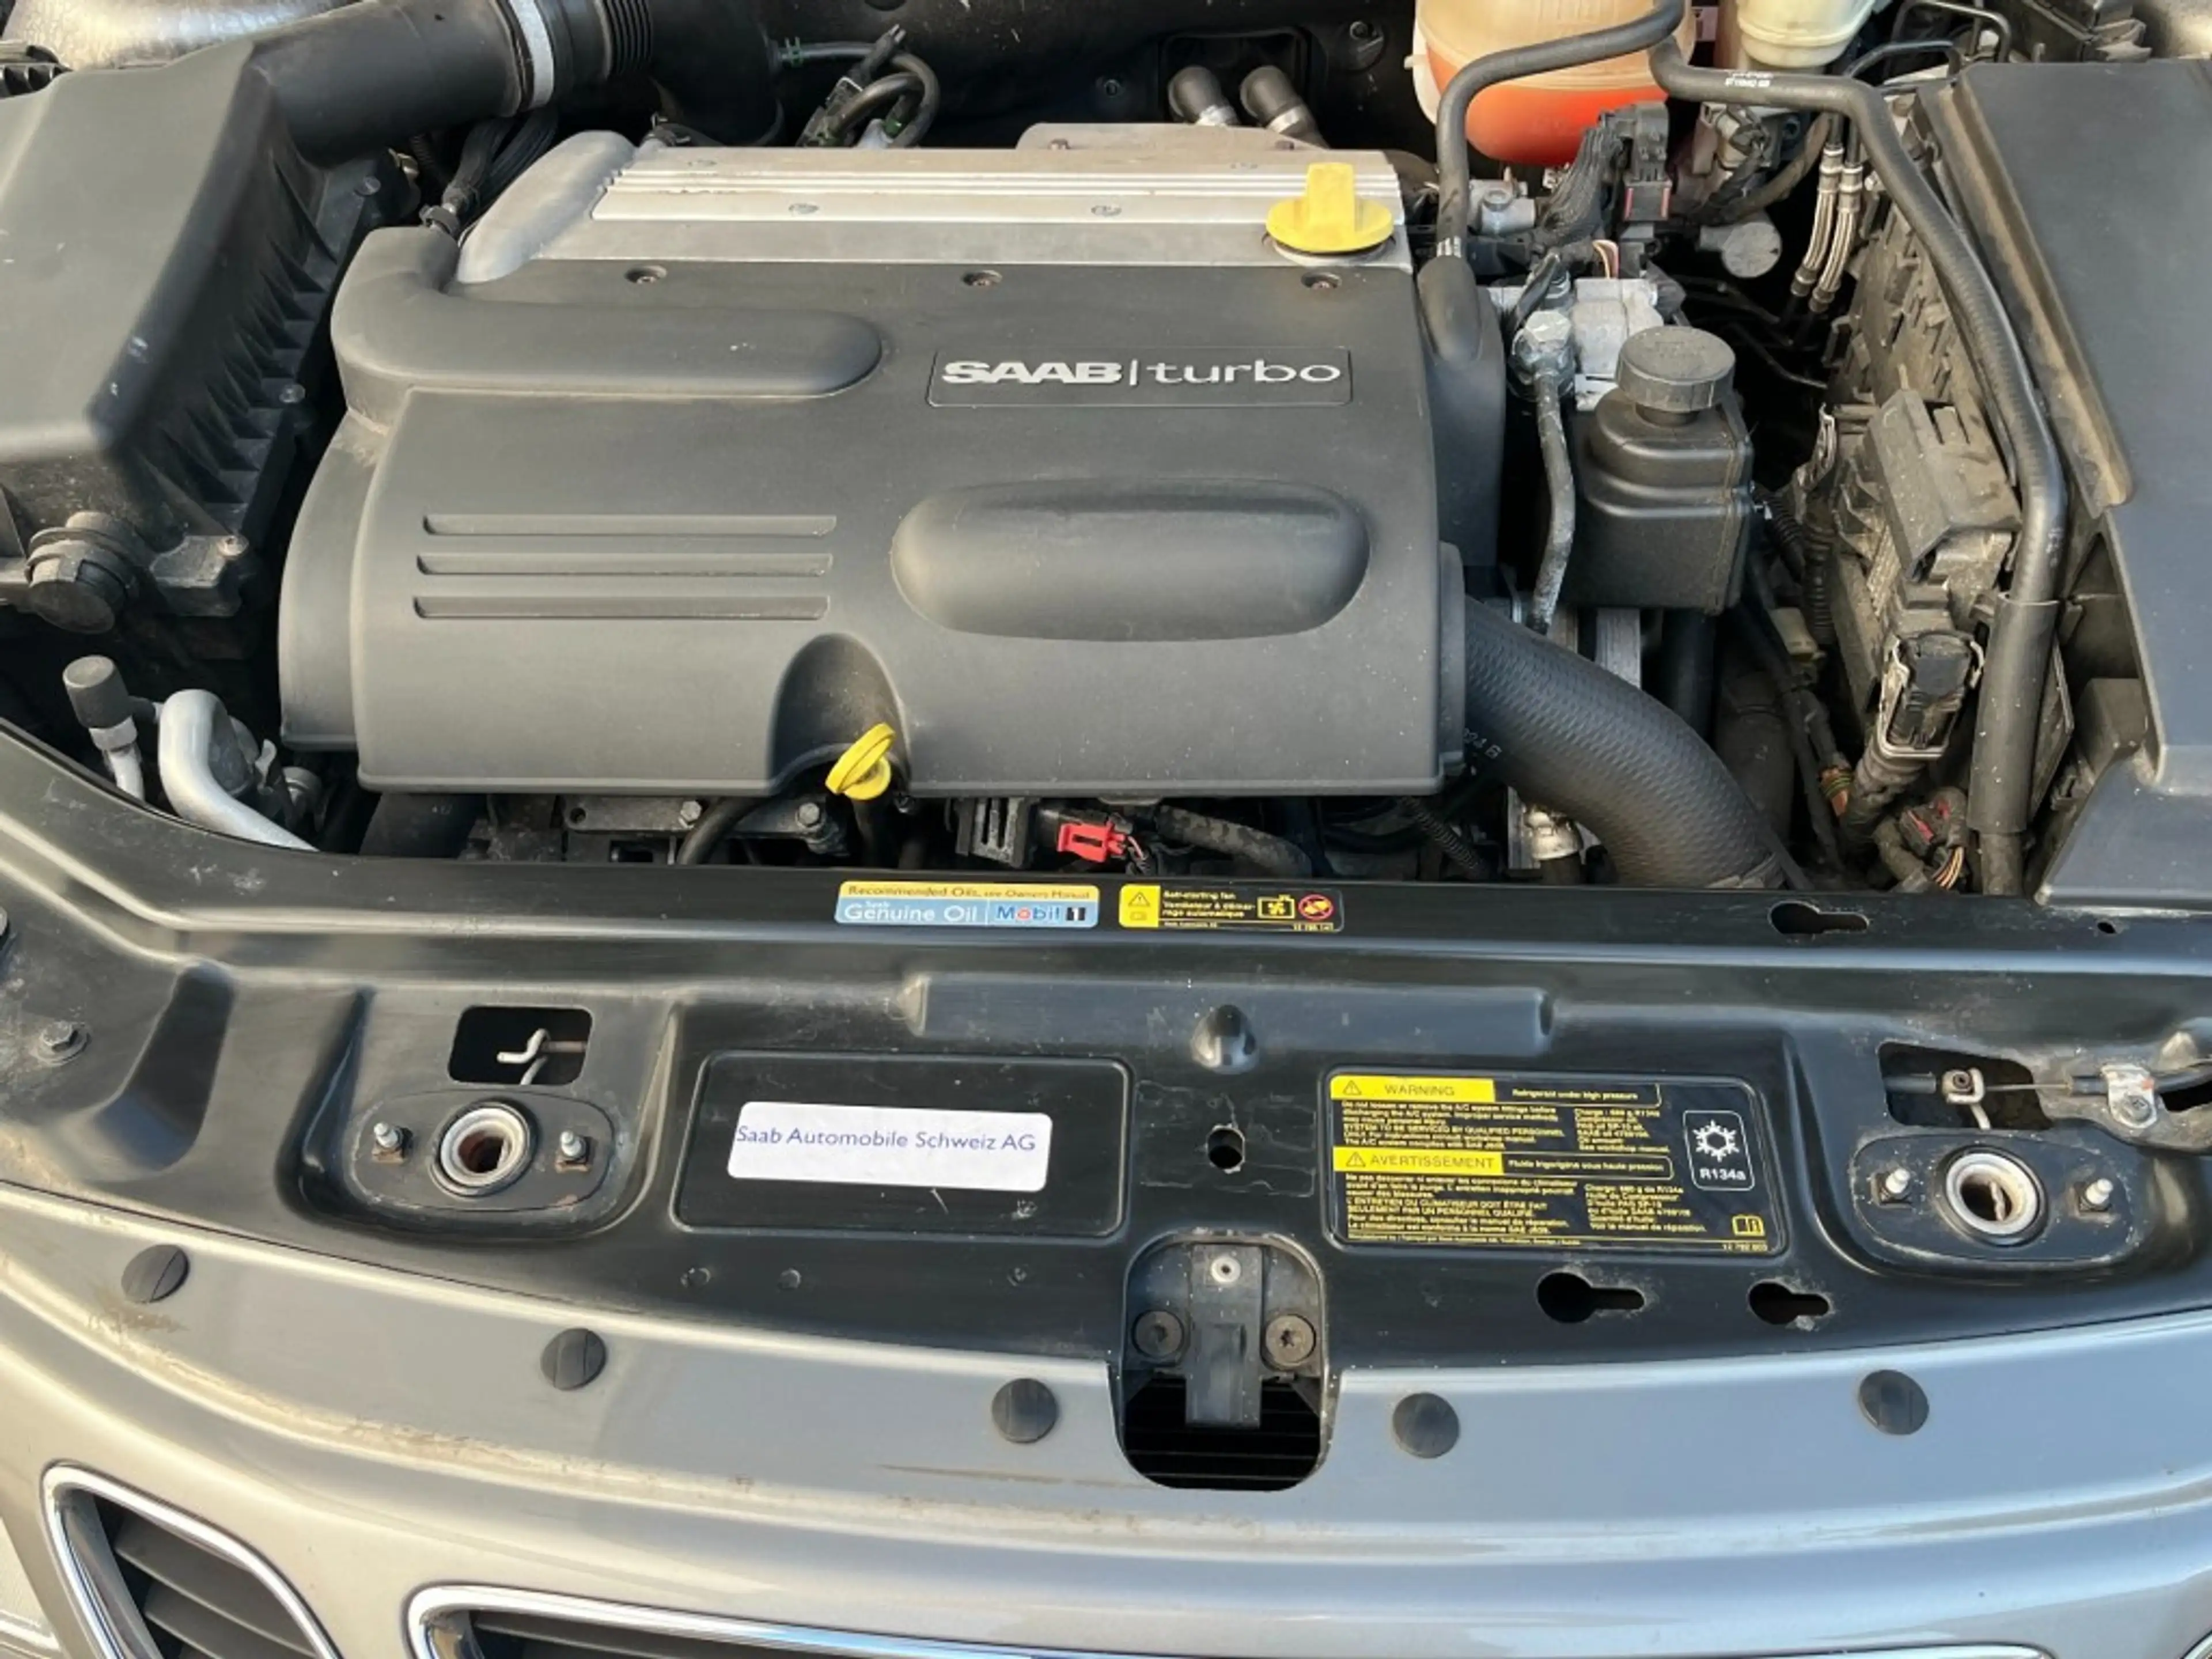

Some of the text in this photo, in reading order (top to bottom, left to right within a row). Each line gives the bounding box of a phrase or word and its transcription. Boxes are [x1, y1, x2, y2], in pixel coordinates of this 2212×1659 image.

[942, 359, 1340, 384] SAAB turbo
[850, 885, 947, 897] Recommended
[844, 903, 978, 922] Genuine Oil
[997, 906, 1059, 919] Mobil
[1385, 1085, 1455, 1096] WARNING
[1583, 1090, 1600, 1100] high
[1602, 1092, 1638, 1101] pressure
[737, 1125, 1036, 1151] Saab Automobile Schweiz AG
[1370, 1154, 1495, 1168] AVERTISSEMENT
[1699, 1167, 1746, 1180] R134a
